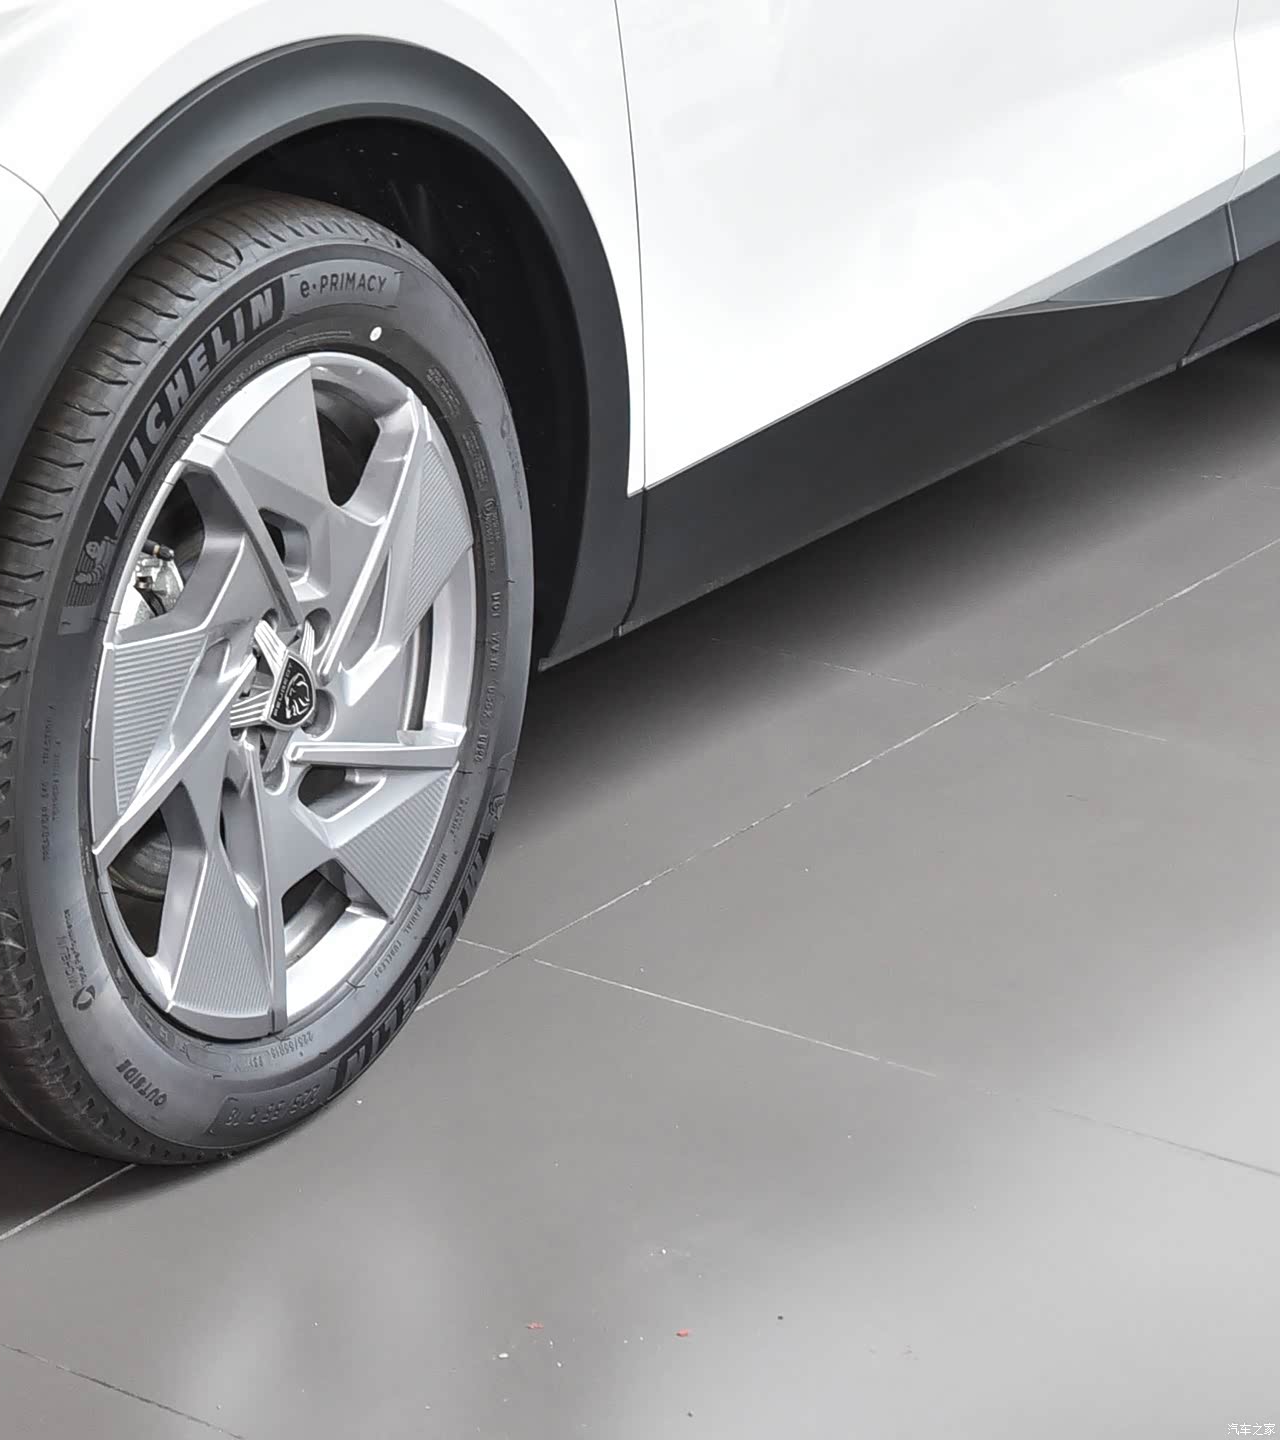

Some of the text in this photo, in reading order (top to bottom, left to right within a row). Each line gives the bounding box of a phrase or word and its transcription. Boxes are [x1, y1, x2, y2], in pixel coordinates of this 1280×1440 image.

[103, 287, 274, 525] MICHELIN
[272, 662, 293, 717] PEUGEOT
[116, 1058, 169, 1107] OUTSIDE
